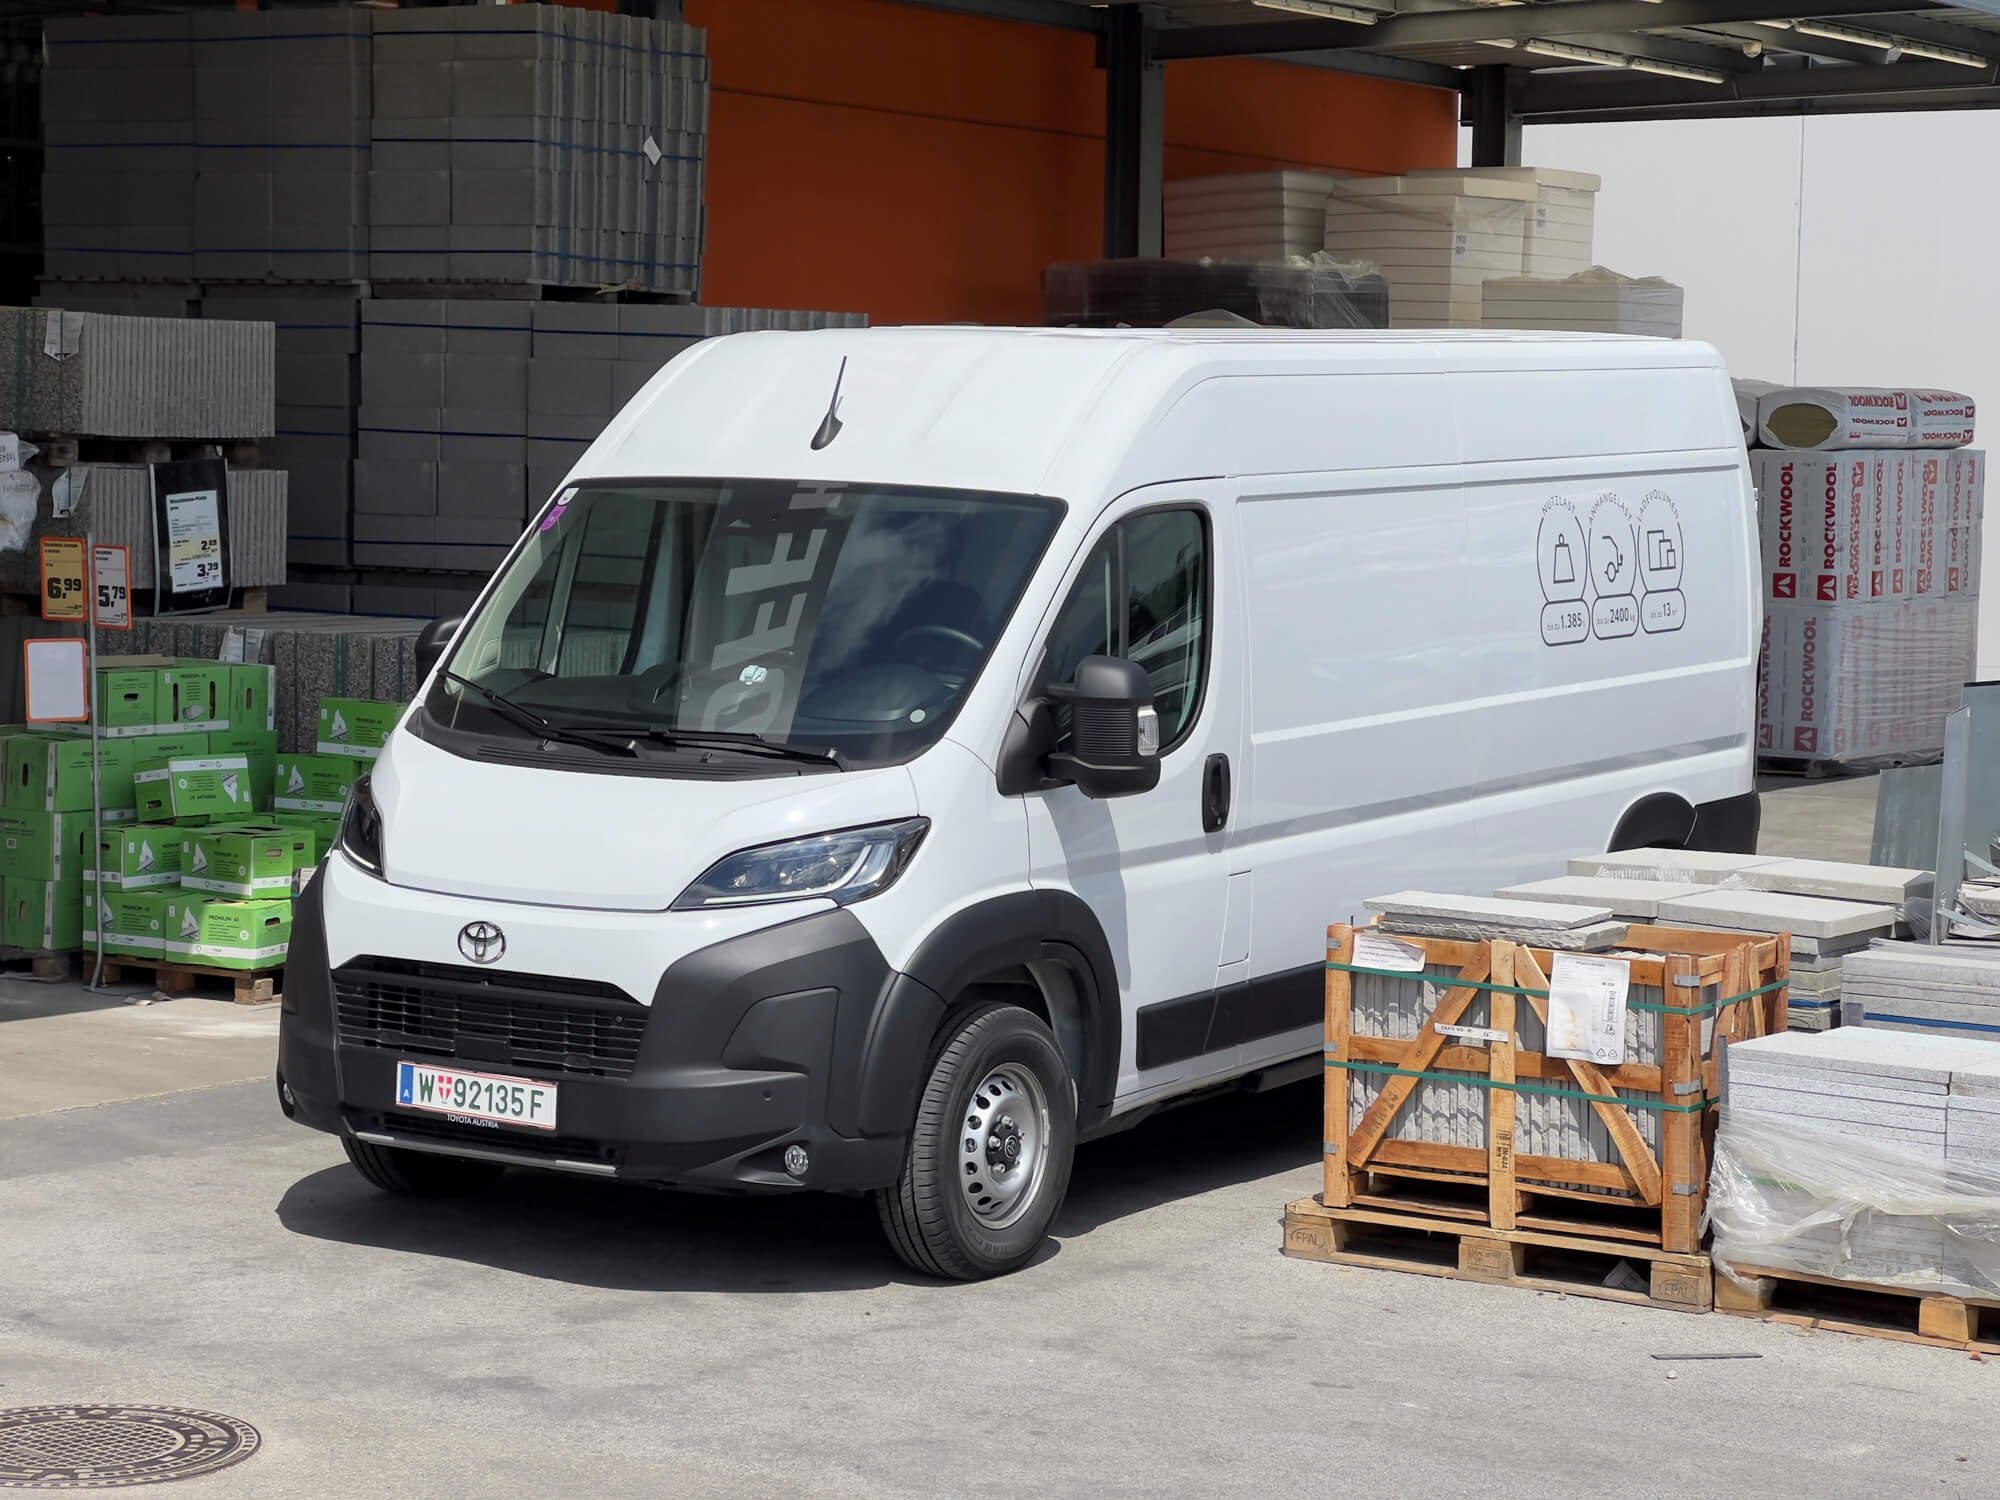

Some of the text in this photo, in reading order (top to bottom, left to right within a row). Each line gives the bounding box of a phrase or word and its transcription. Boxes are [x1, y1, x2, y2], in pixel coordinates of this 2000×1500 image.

[1848, 394, 1894, 408] ROCKWOOL
[1923, 408, 1963, 417] ROCKWOOL
[1541, 495, 1577, 516] NUTZLAST
[1637, 489, 1680, 523] LADEVOLUMEN
[1778, 462, 1794, 568] ROCKWOOL
[1824, 462, 1837, 570] ROCKWOOL
[1874, 458, 1884, 566] ROCKWOOL
[1895, 455, 1904, 564] ROCKWOOL
[1610, 607, 1630, 624] 2400
[1663, 602, 1672, 617] 13
[1560, 612, 1582, 629] 1.385
[1802, 617, 1817, 721] ROCKWOOL
[403, 1089, 410, 1098] A
[419, 1072, 544, 1118] W 92135F
[447, 1114, 499, 1129] TOYOTA AUSTRIA
